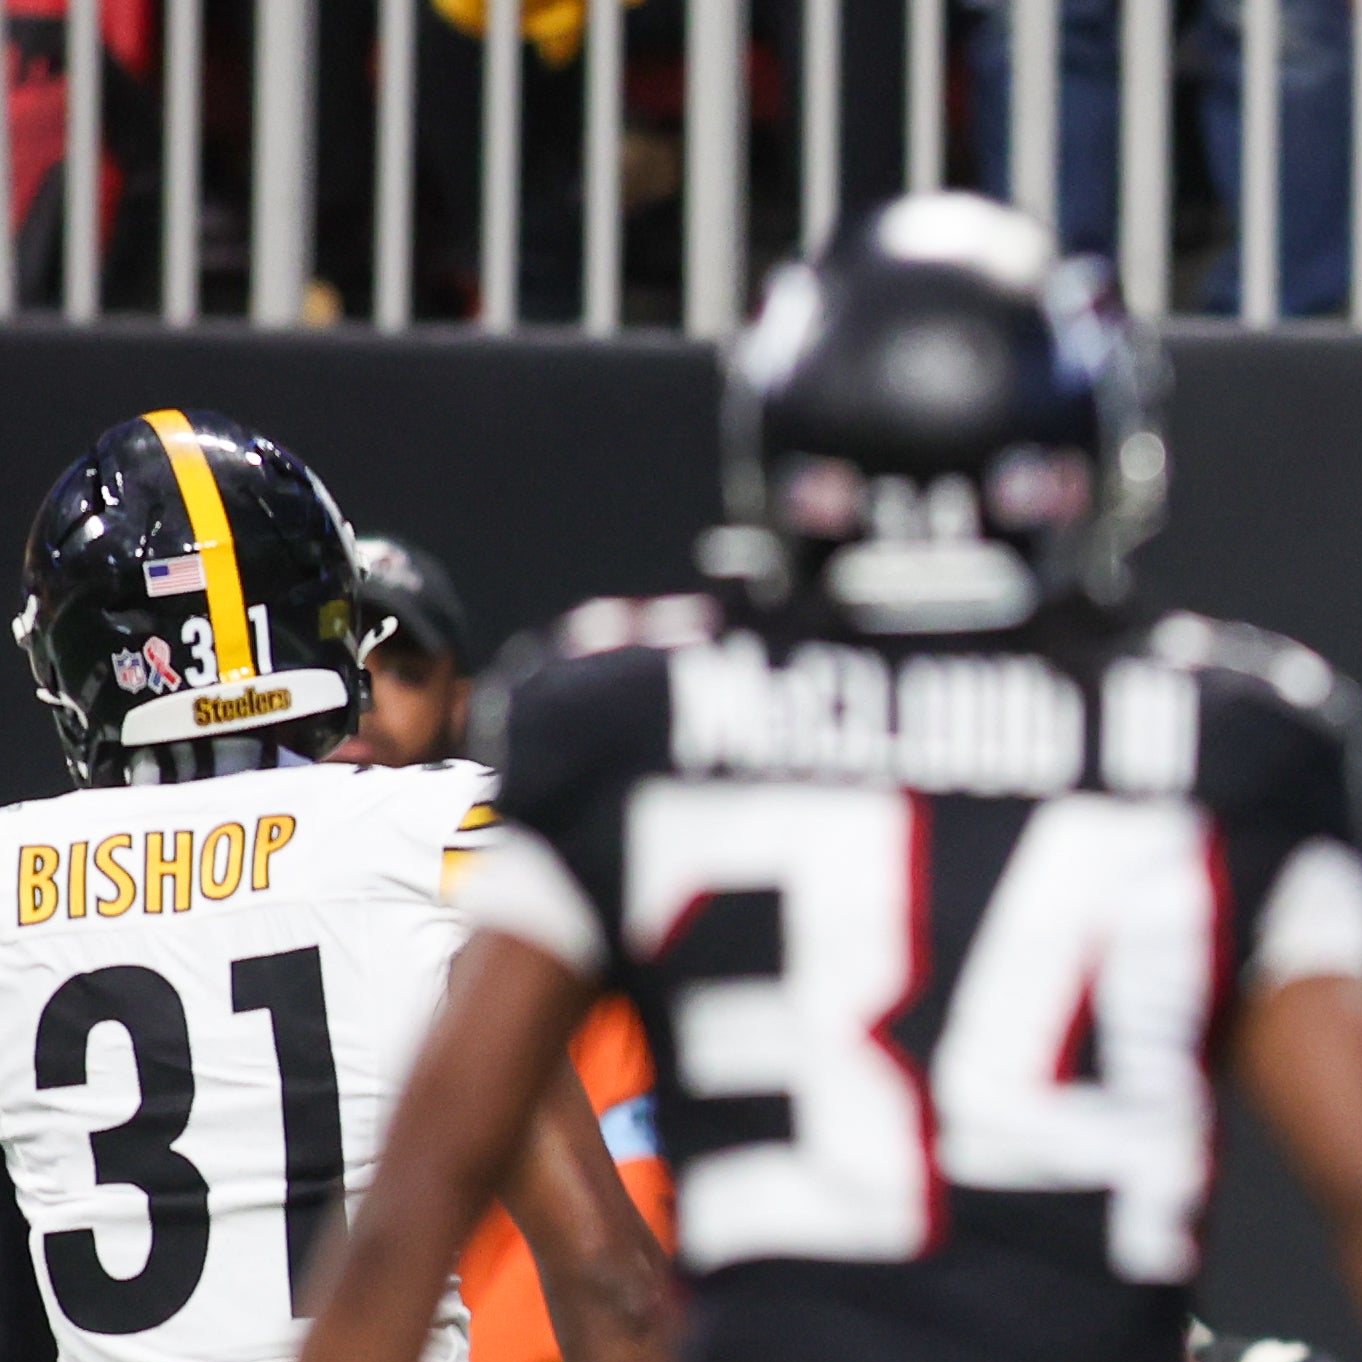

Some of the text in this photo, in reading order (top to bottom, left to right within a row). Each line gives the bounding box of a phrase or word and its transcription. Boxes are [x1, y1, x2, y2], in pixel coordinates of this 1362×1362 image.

[181, 603, 273, 689] 31
[194, 686, 292, 726] Steelers
[17, 813, 296, 927] BISHOP
[622, 775, 1235, 1285] 34
[34, 945, 349, 1335] 31
